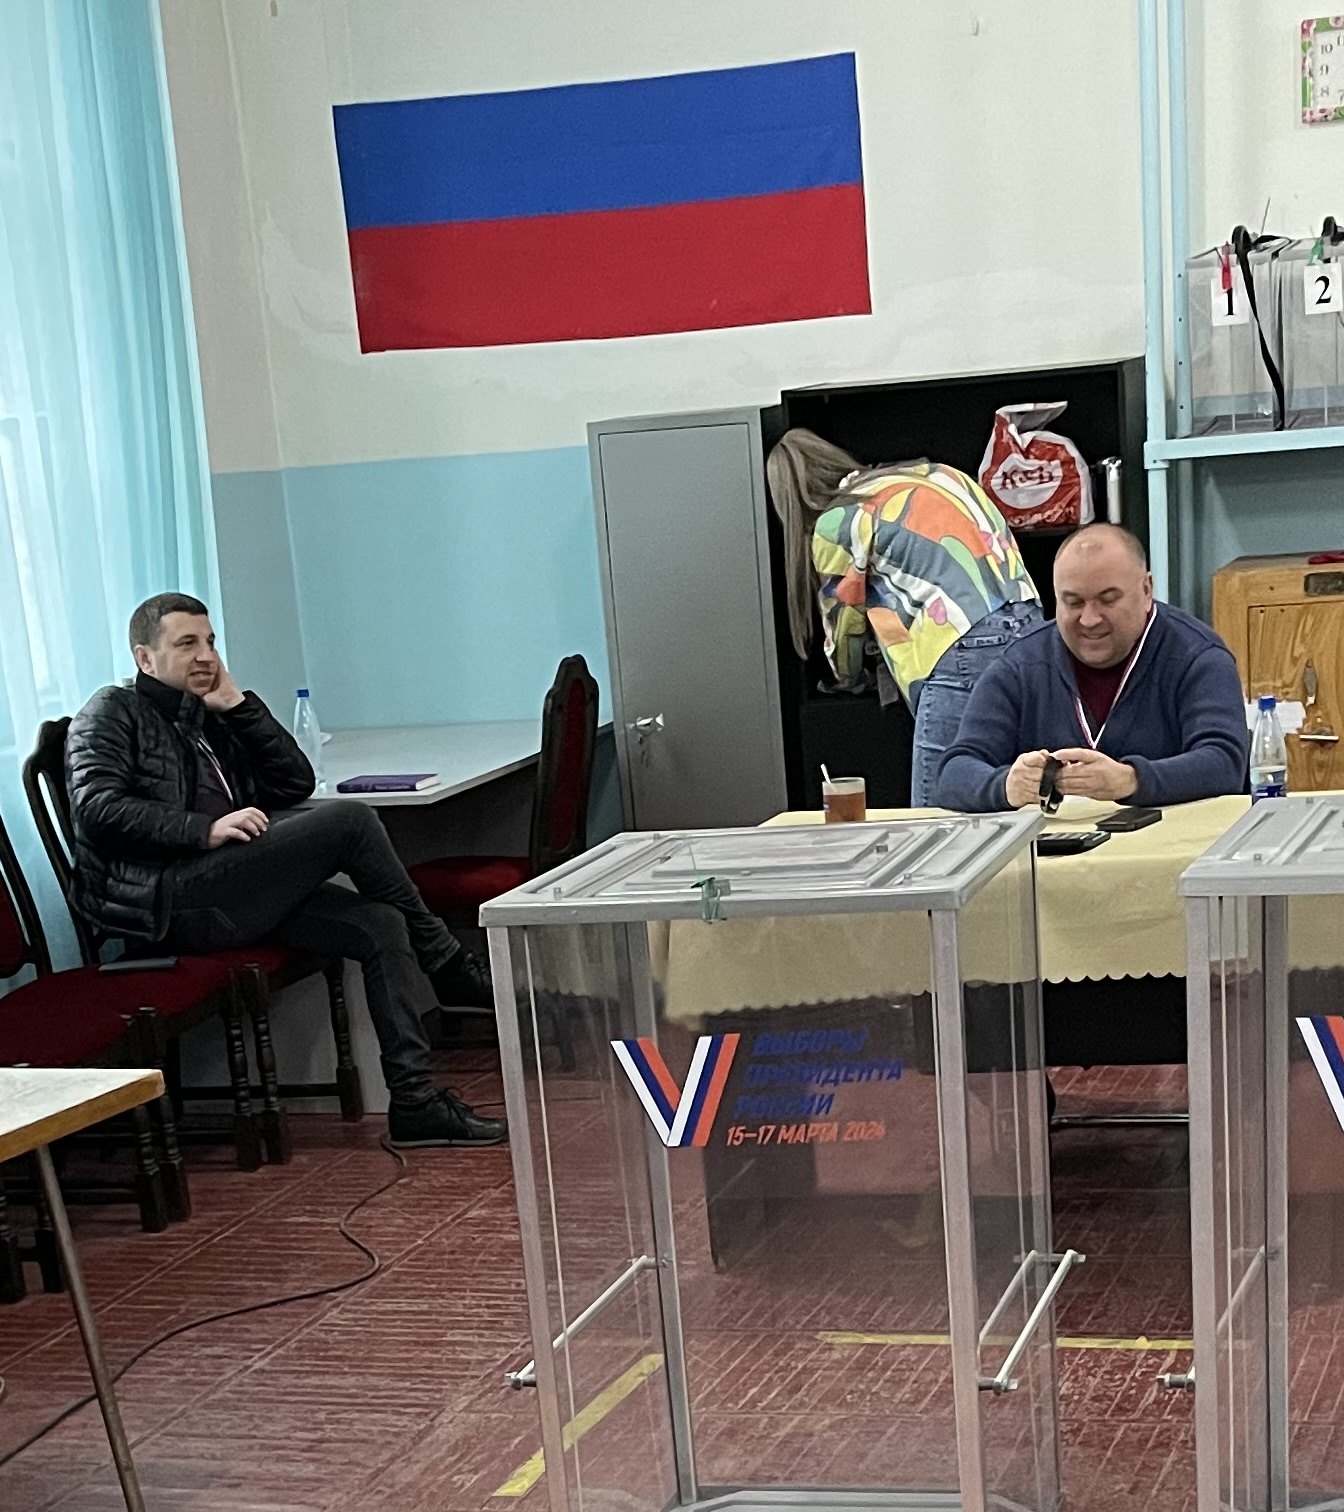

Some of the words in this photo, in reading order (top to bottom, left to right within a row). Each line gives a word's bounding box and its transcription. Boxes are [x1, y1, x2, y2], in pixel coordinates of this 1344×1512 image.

[1320, 43, 1333, 55] 10
[1320, 64, 1329, 76] 9
[1320, 86, 1330, 97] 8
[1314, 275, 1332, 305] 2
[1224, 287, 1235, 316] 1
[777, 1122, 838, 1145] МАРТА
